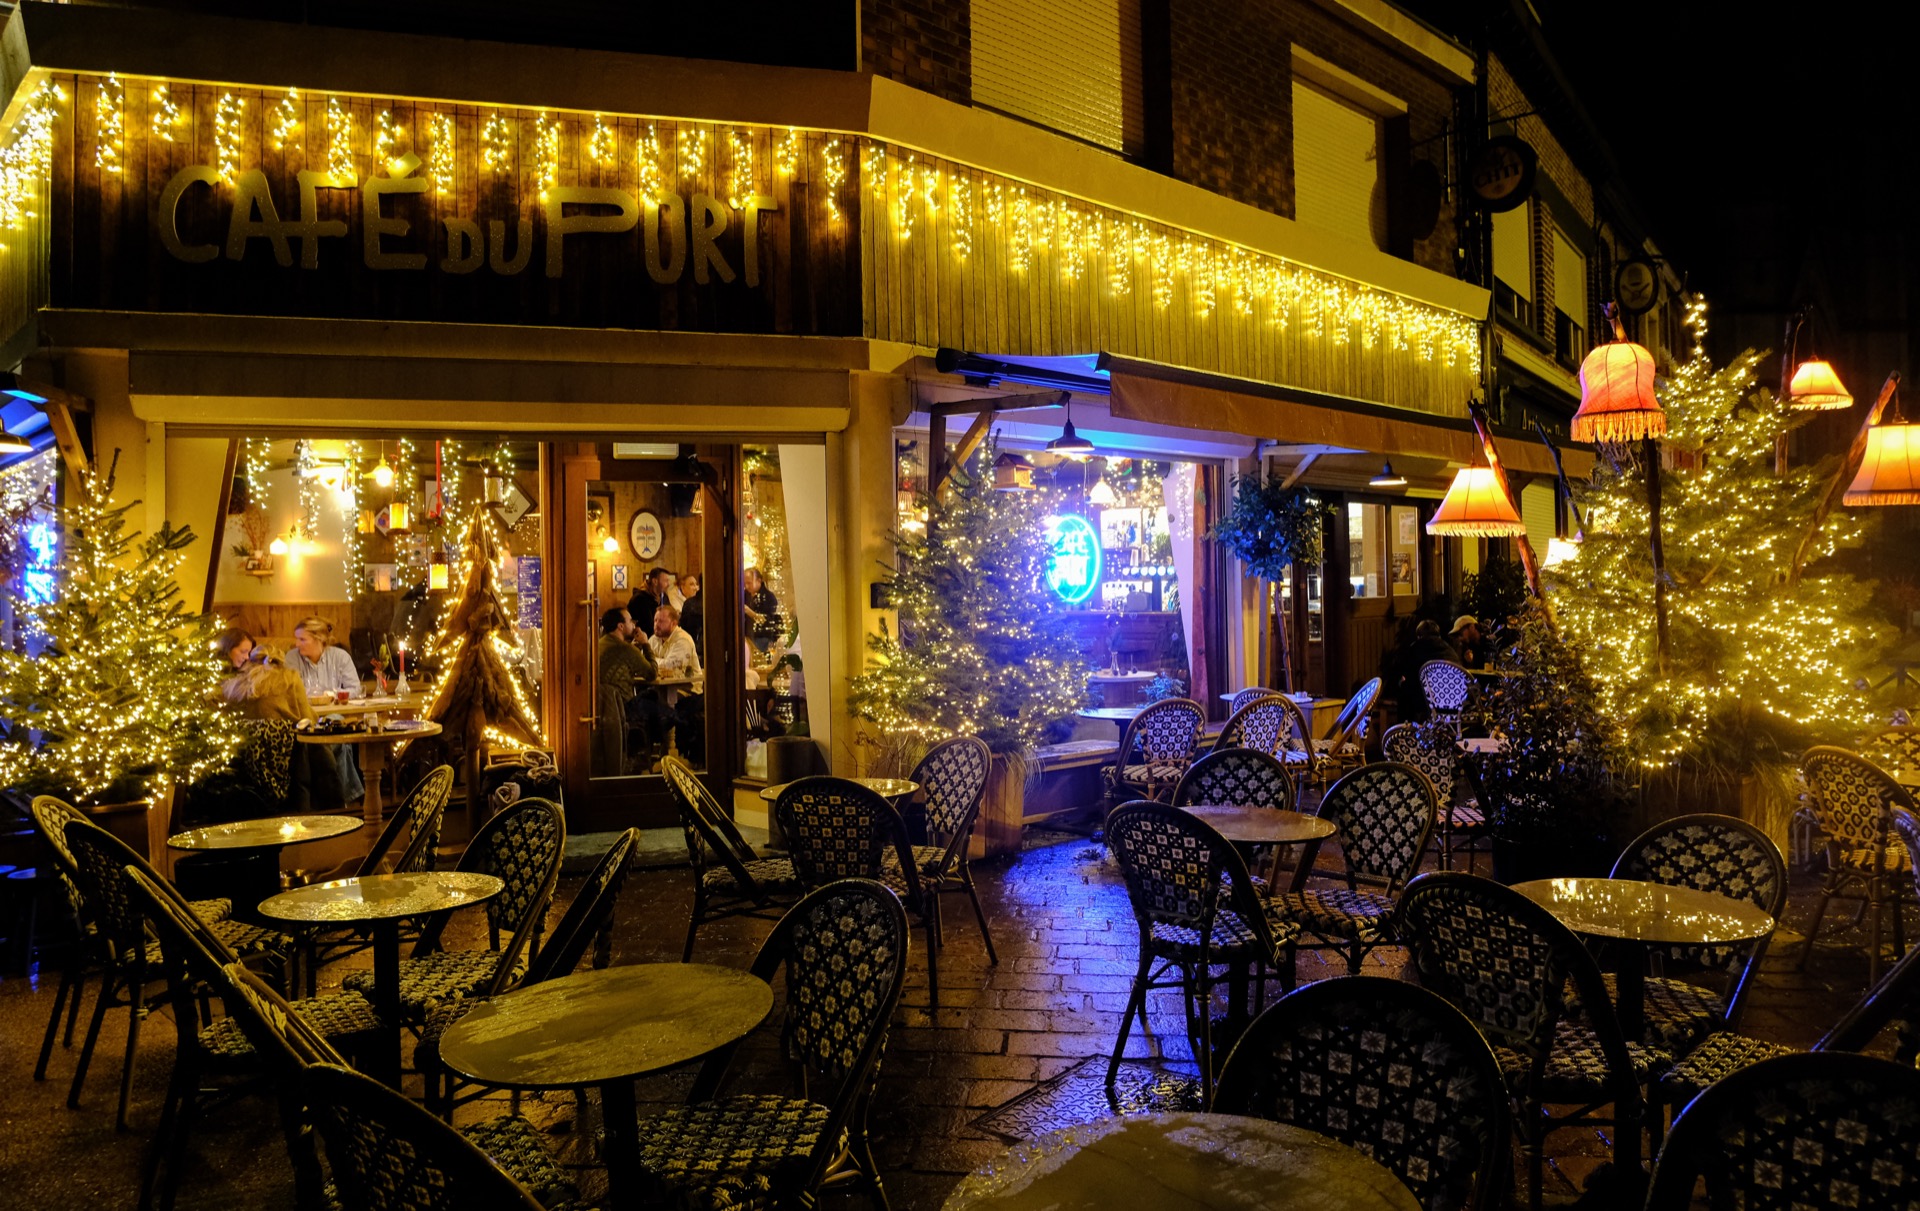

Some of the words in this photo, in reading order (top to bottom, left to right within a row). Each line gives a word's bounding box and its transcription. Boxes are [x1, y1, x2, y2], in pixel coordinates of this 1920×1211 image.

[158, 151, 430, 270] CAFÉ
[440, 217, 533, 276] DU
[546, 187, 778, 288] PORT
[1522, 408, 1552, 434] Artian
